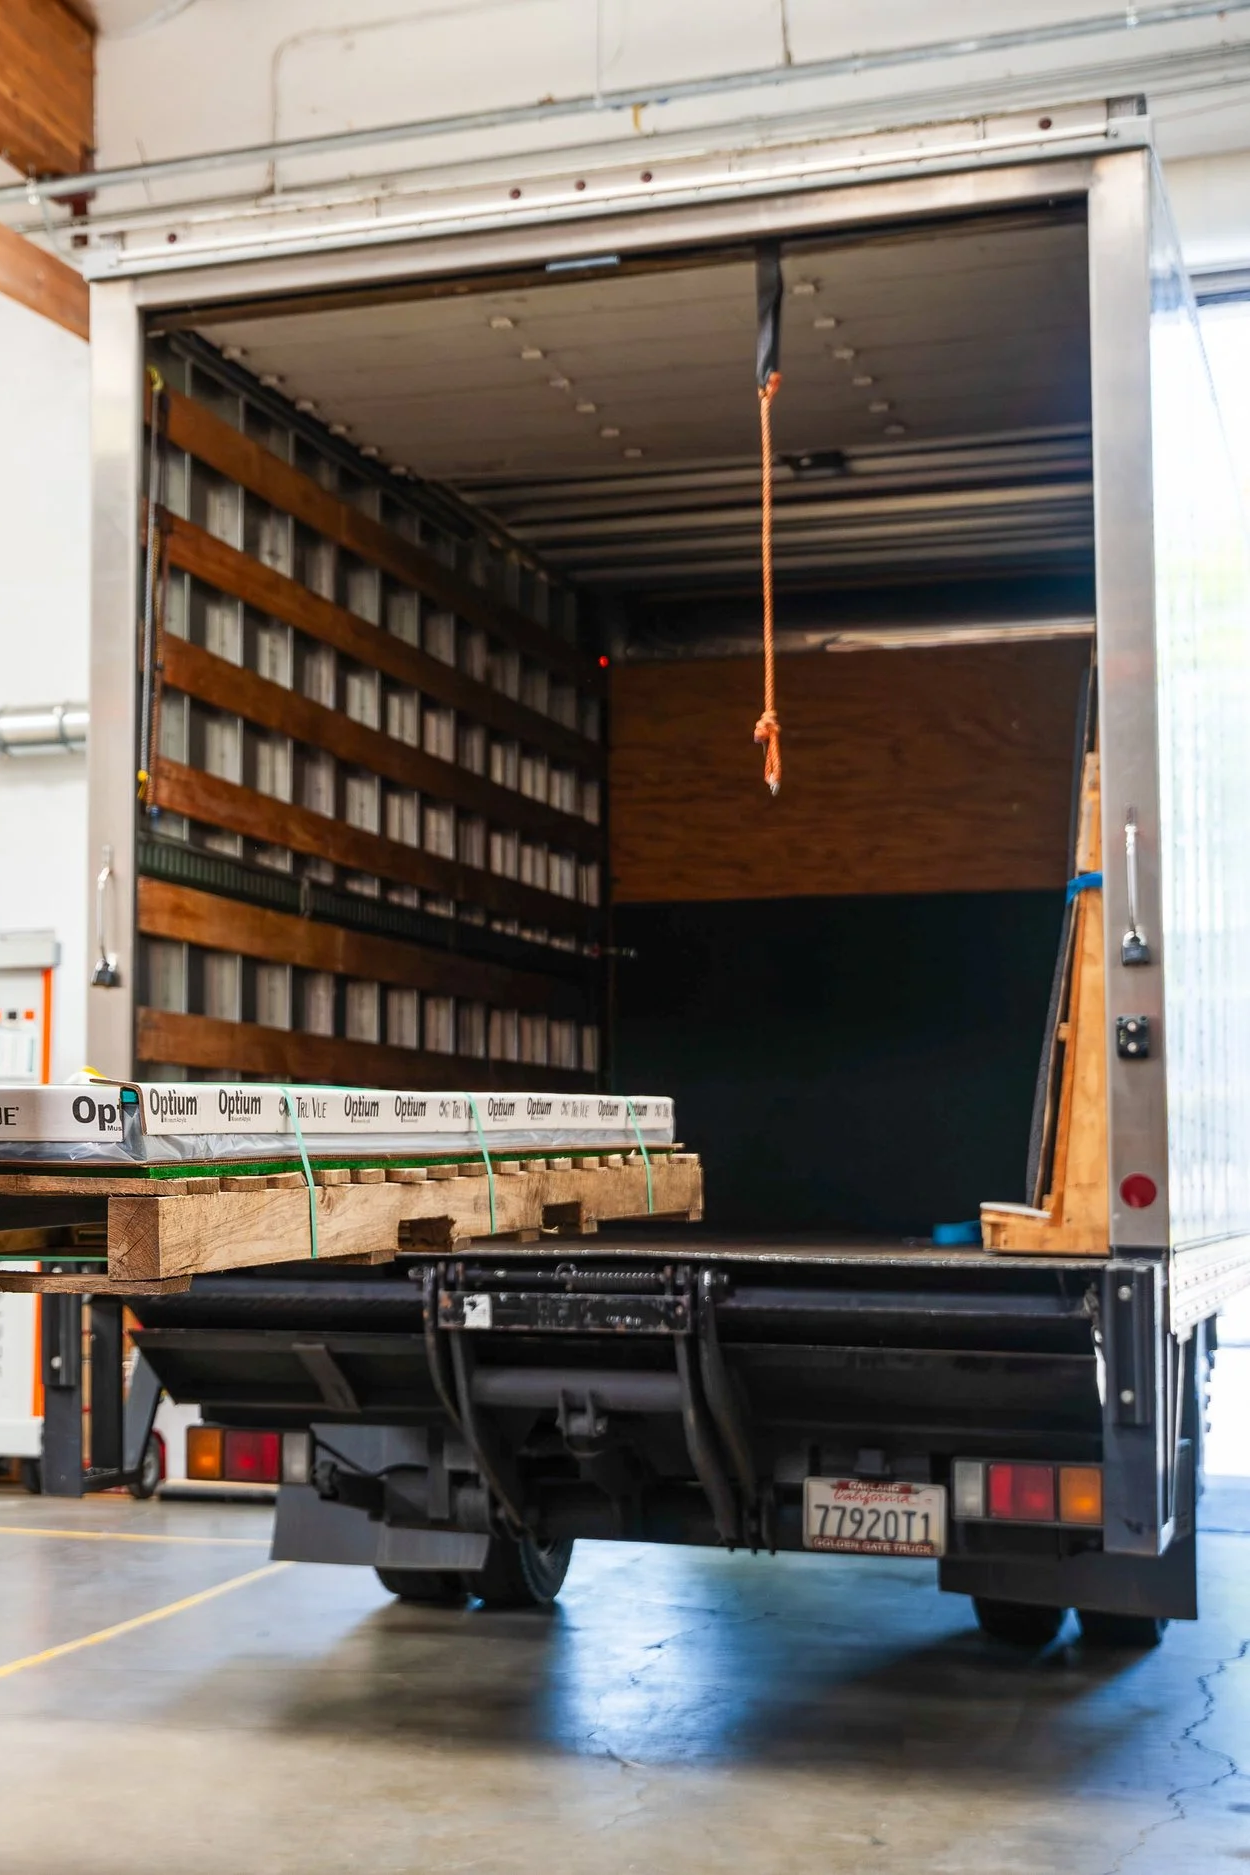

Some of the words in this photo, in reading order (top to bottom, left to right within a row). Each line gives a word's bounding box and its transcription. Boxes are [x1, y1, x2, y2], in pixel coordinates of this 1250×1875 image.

[150, 1088, 198, 1123] Optium
[218, 1088, 262, 1122] Optium
[344, 1094, 380, 1123] Optium
[394, 1095, 427, 1123] Optium
[487, 1097, 516, 1122] Optium
[526, 1097, 552, 1121] Optium
[598, 1099, 619, 1119] Optium
[834, 1487, 912, 1505] California
[814, 1504, 931, 1544] 77920T1
